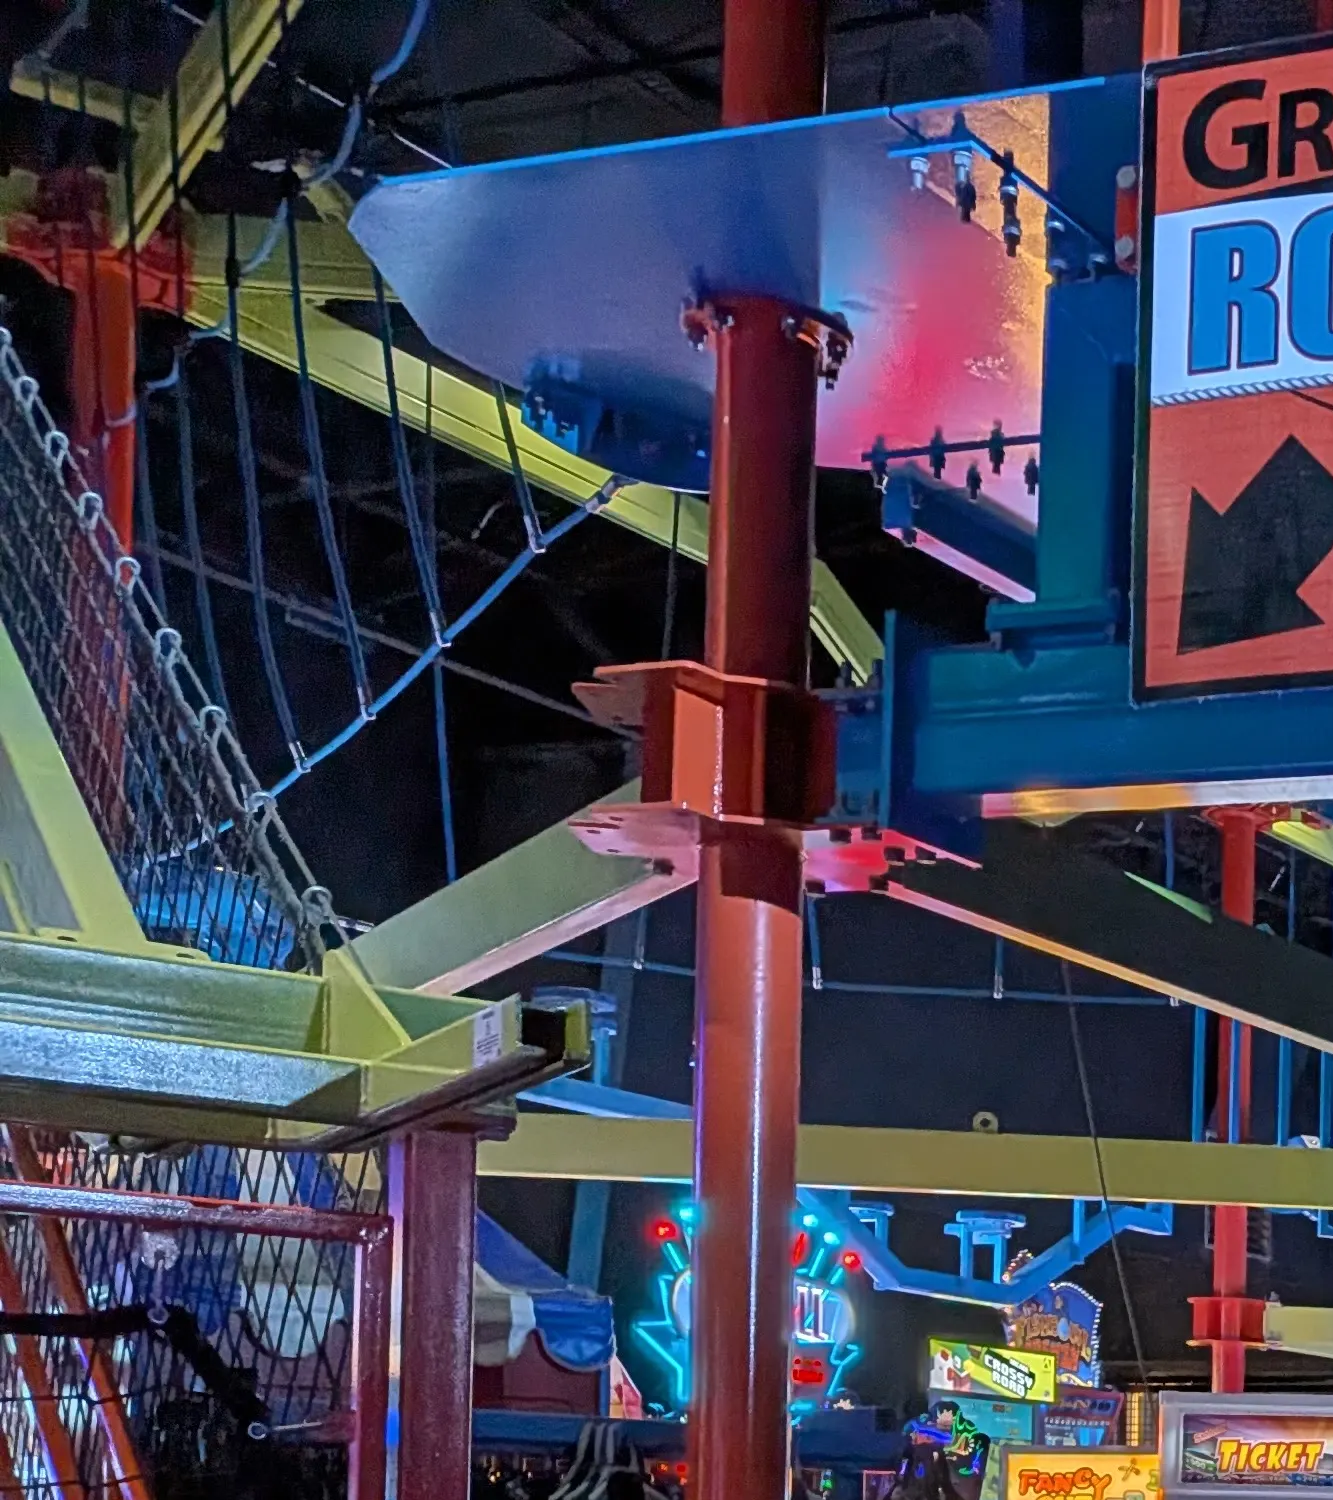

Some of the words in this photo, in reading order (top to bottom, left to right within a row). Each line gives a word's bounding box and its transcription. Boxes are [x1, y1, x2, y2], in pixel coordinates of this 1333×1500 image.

[984, 1354, 1034, 1389] CROSSY
[992, 1370, 1026, 1397] ROAD
[1217, 1438, 1325, 1474] TICKET
